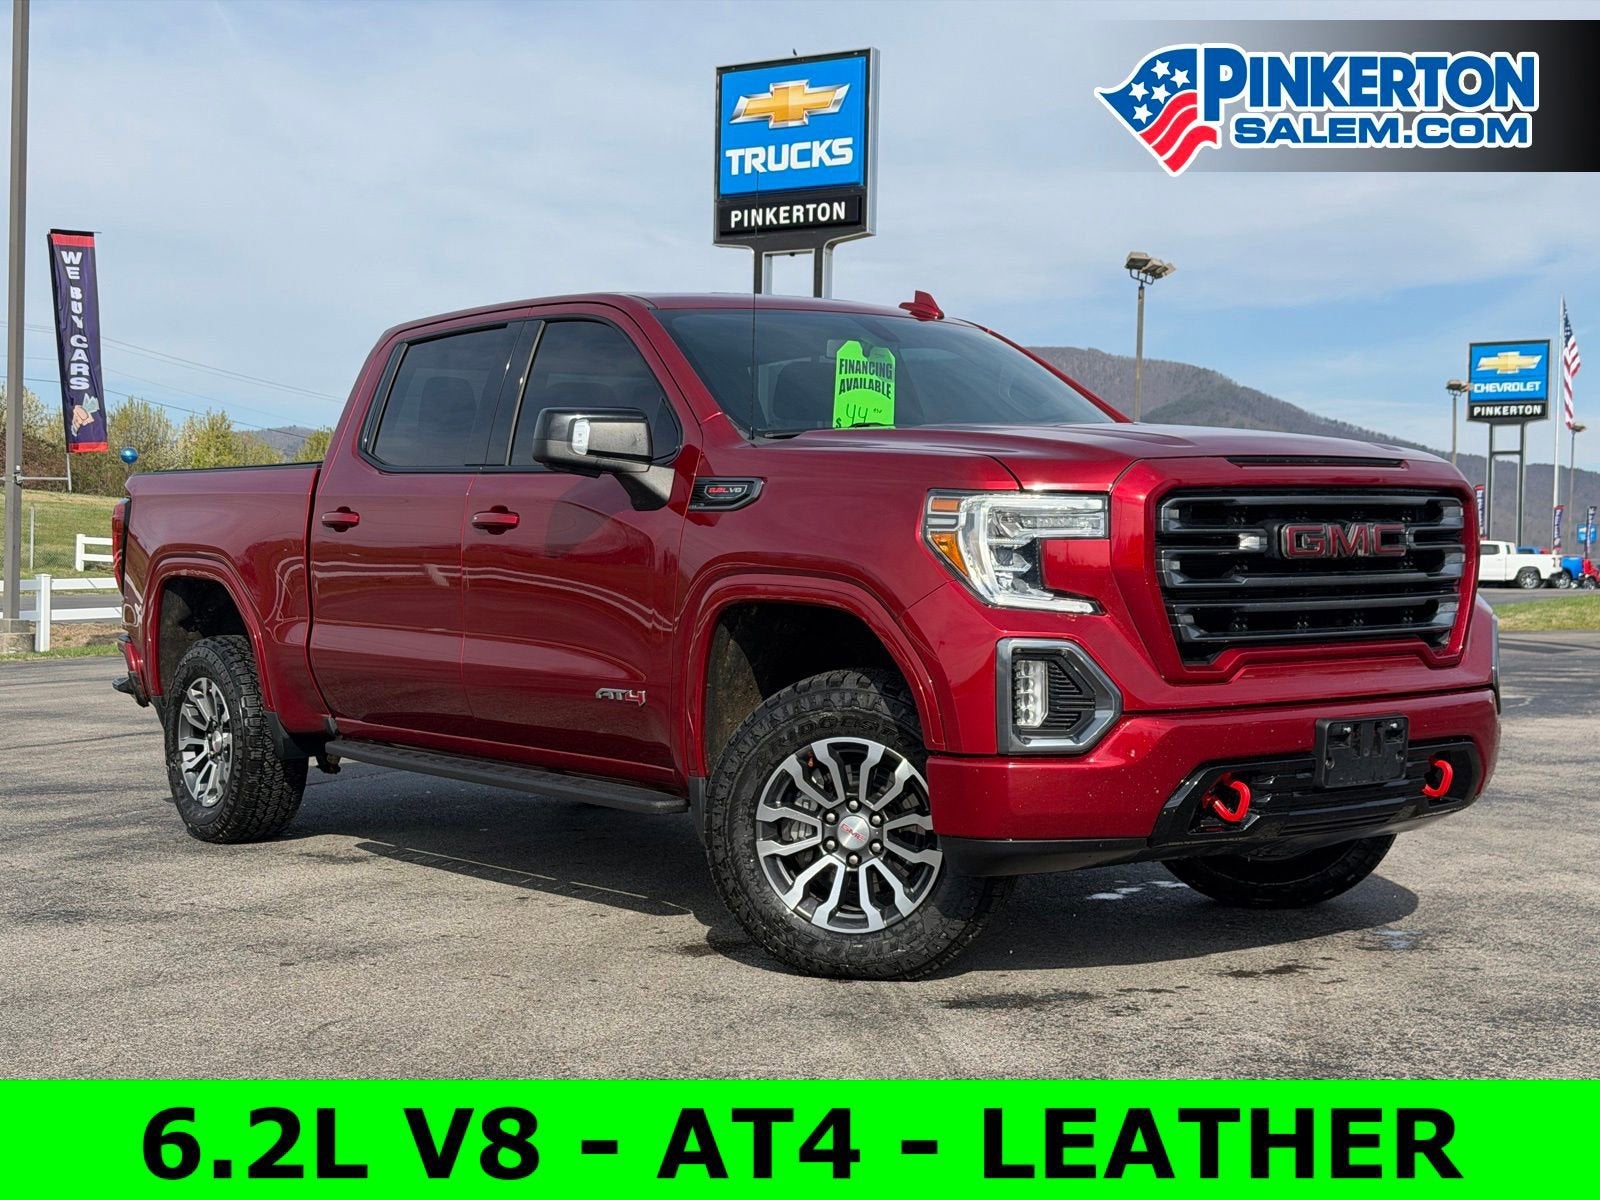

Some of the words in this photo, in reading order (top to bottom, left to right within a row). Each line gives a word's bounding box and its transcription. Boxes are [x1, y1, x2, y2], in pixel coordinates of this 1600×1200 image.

[725, 137, 853, 176] TRUCKS
[730, 201, 846, 228] PINKERTON
[61, 250, 82, 280] WE
[70, 285, 84, 329] BUY
[69, 334, 90, 390] CARS
[839, 358, 893, 380] FINANCING
[839, 377, 892, 400] AVAILABLE
[1473, 380, 1541, 393] CHEVROLET
[1473, 404, 1543, 417] PINKERTON
[1281, 522, 1408, 559] GMC
[595, 687, 646, 707] AT4
